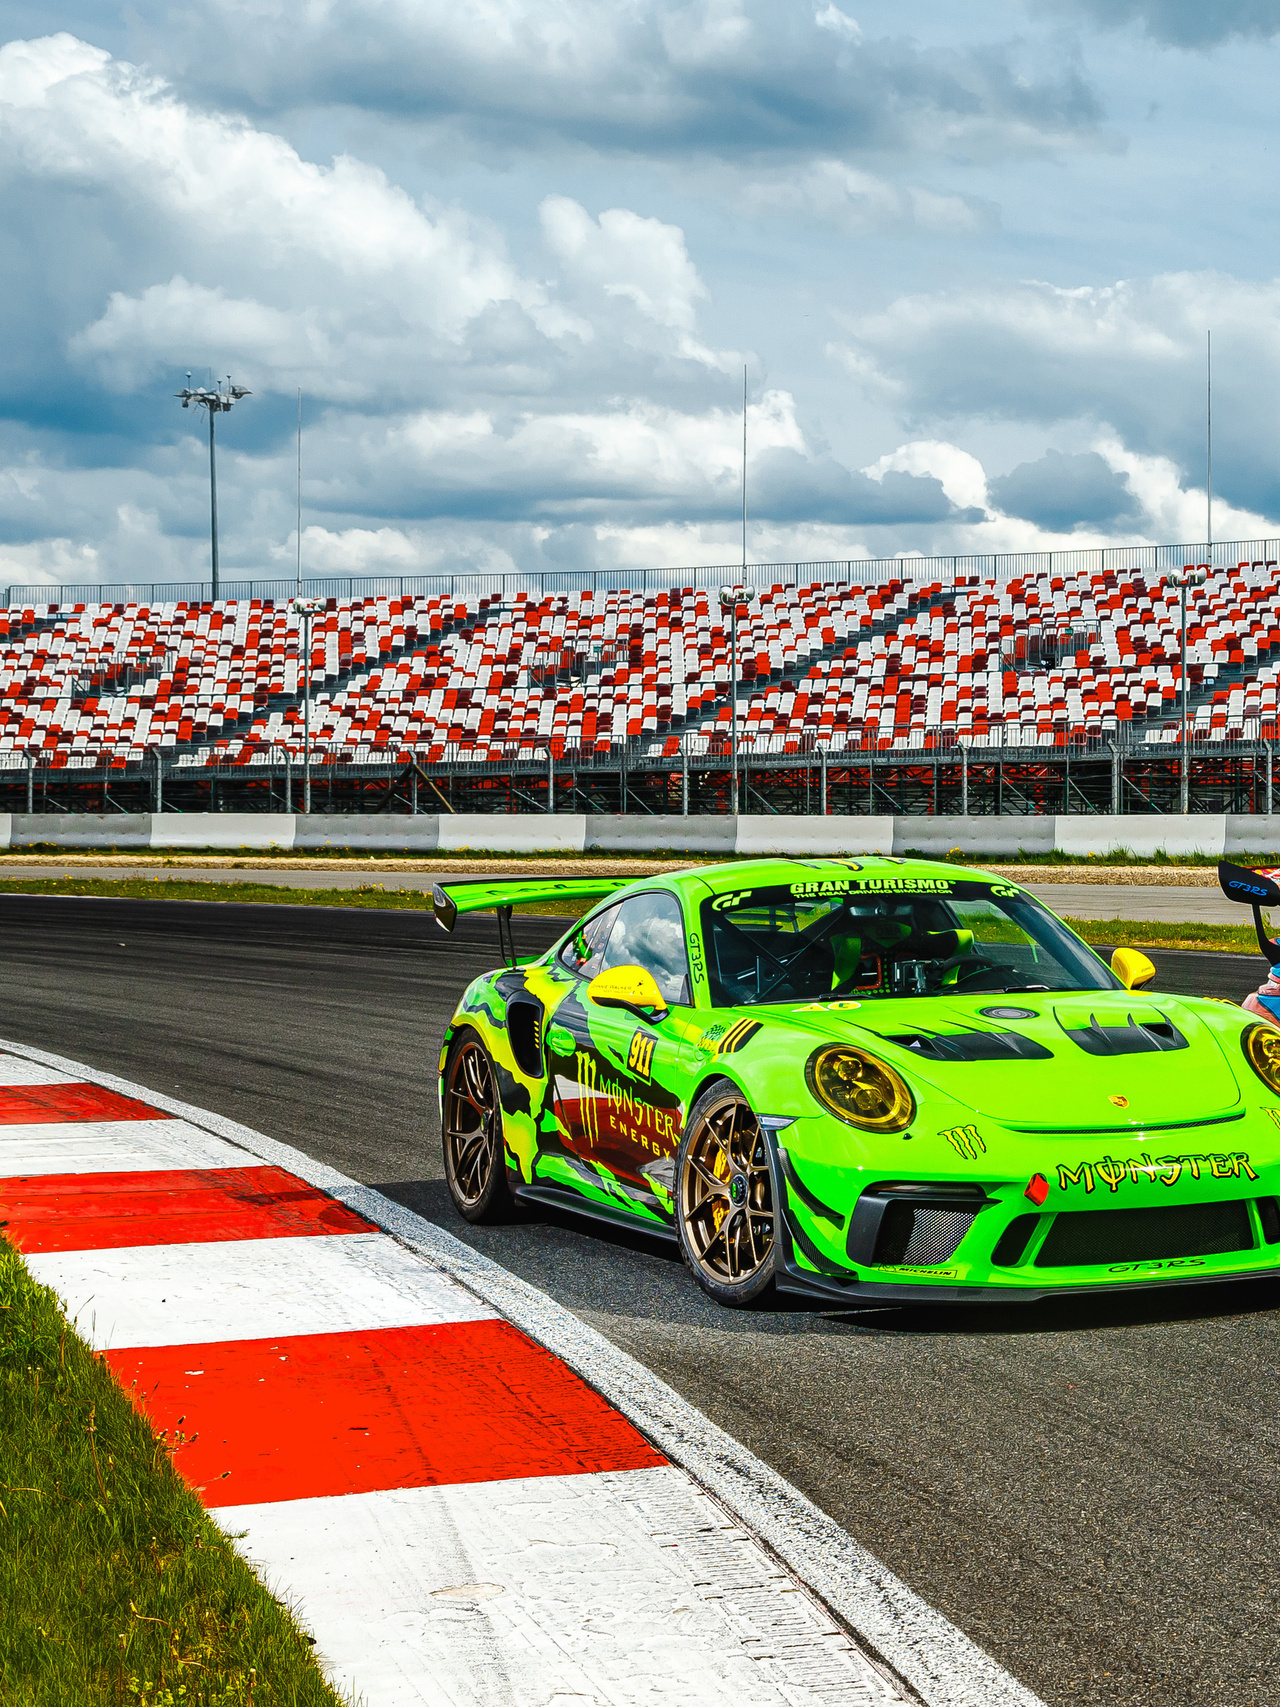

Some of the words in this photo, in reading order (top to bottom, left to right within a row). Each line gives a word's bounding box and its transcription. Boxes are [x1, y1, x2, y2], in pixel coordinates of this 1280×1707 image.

[790, 880, 849, 894] GRAN
[858, 879, 950, 890] TURISMO
[1229, 880, 1268, 896] GT3RS
[690, 932, 704, 984] GT3RS
[629, 1032, 653, 1077] 911
[610, 1115, 671, 1161] ENERGY
[899, 1267, 952, 1275] MICHELIN
[1108, 1259, 1206, 1273] GT3RS
